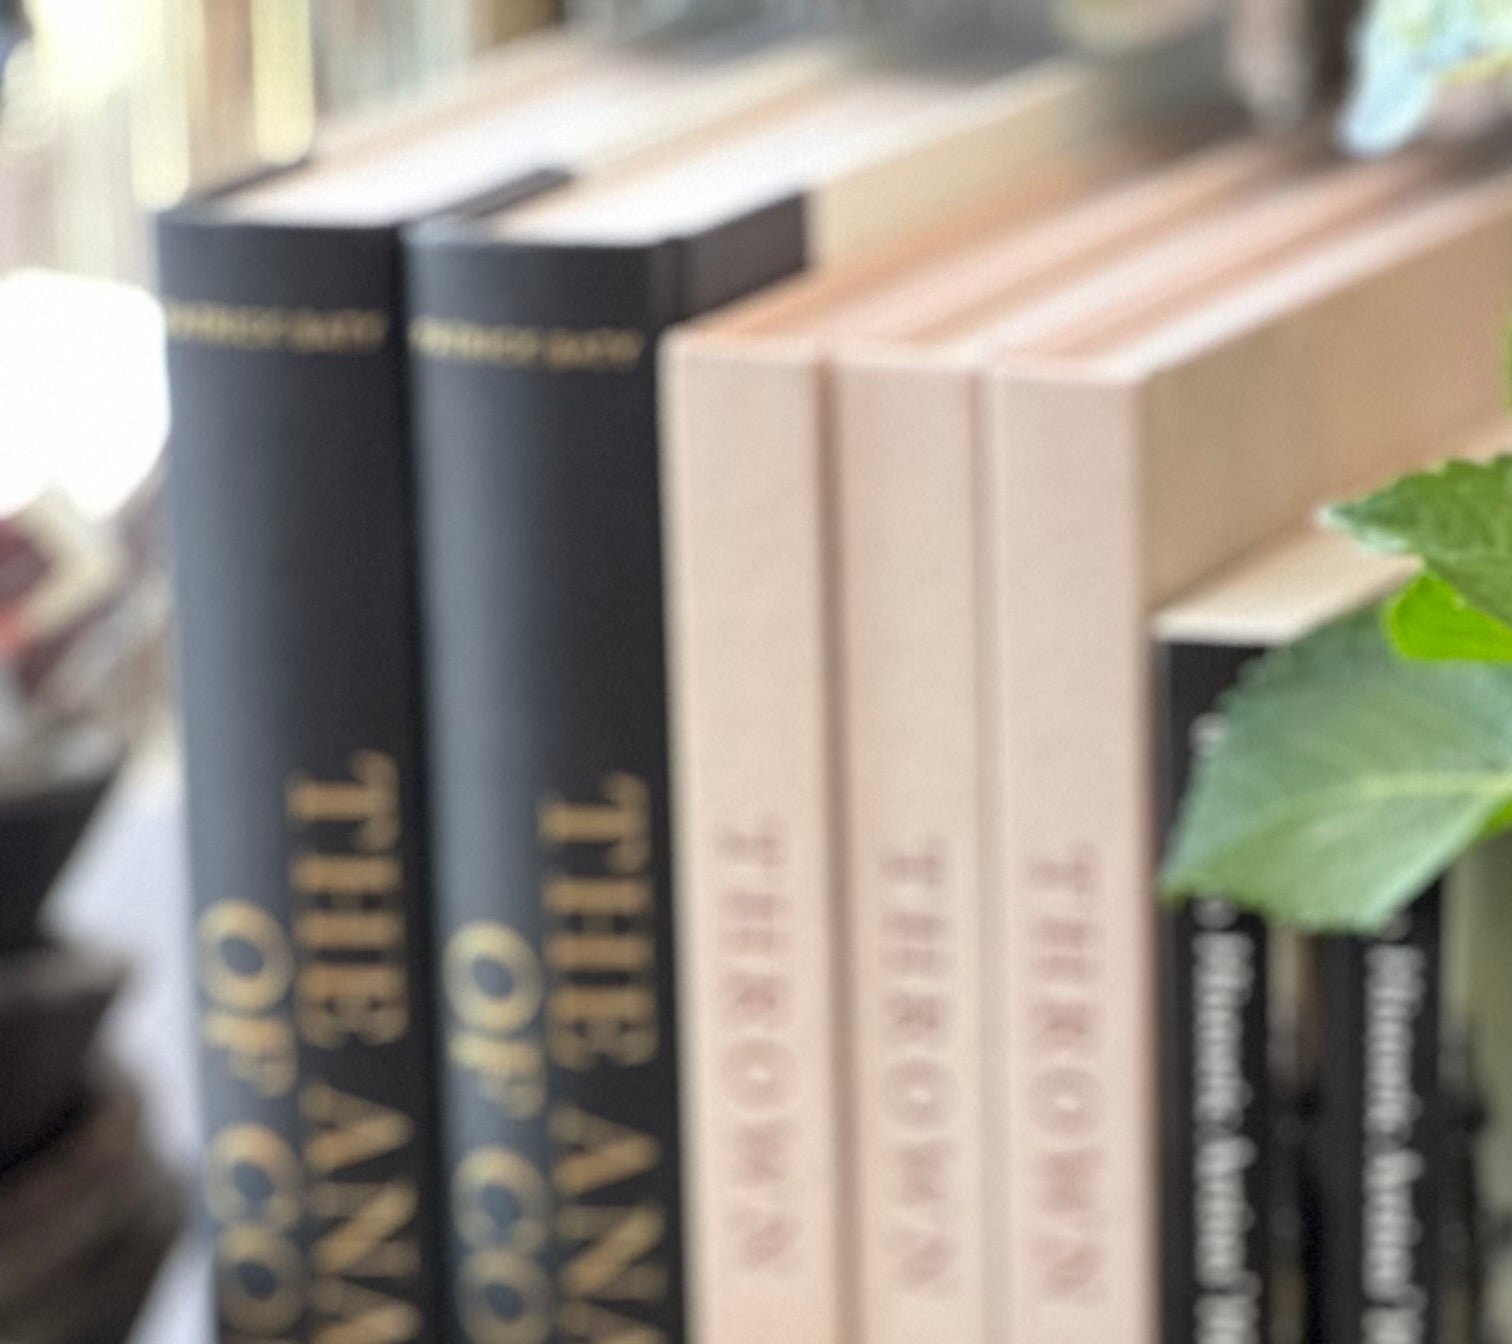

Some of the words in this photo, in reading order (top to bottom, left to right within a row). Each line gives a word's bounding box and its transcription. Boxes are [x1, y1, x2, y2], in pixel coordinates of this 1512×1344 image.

[198, 897, 299, 1099] OF
[285, 749, 409, 1049] THE
[443, 918, 549, 1121] OF
[537, 770, 659, 1072] THE
[714, 815, 799, 1282] THROWN
[875, 834, 962, 1302] THROWN
[1025, 838, 1105, 1308] THROWN
